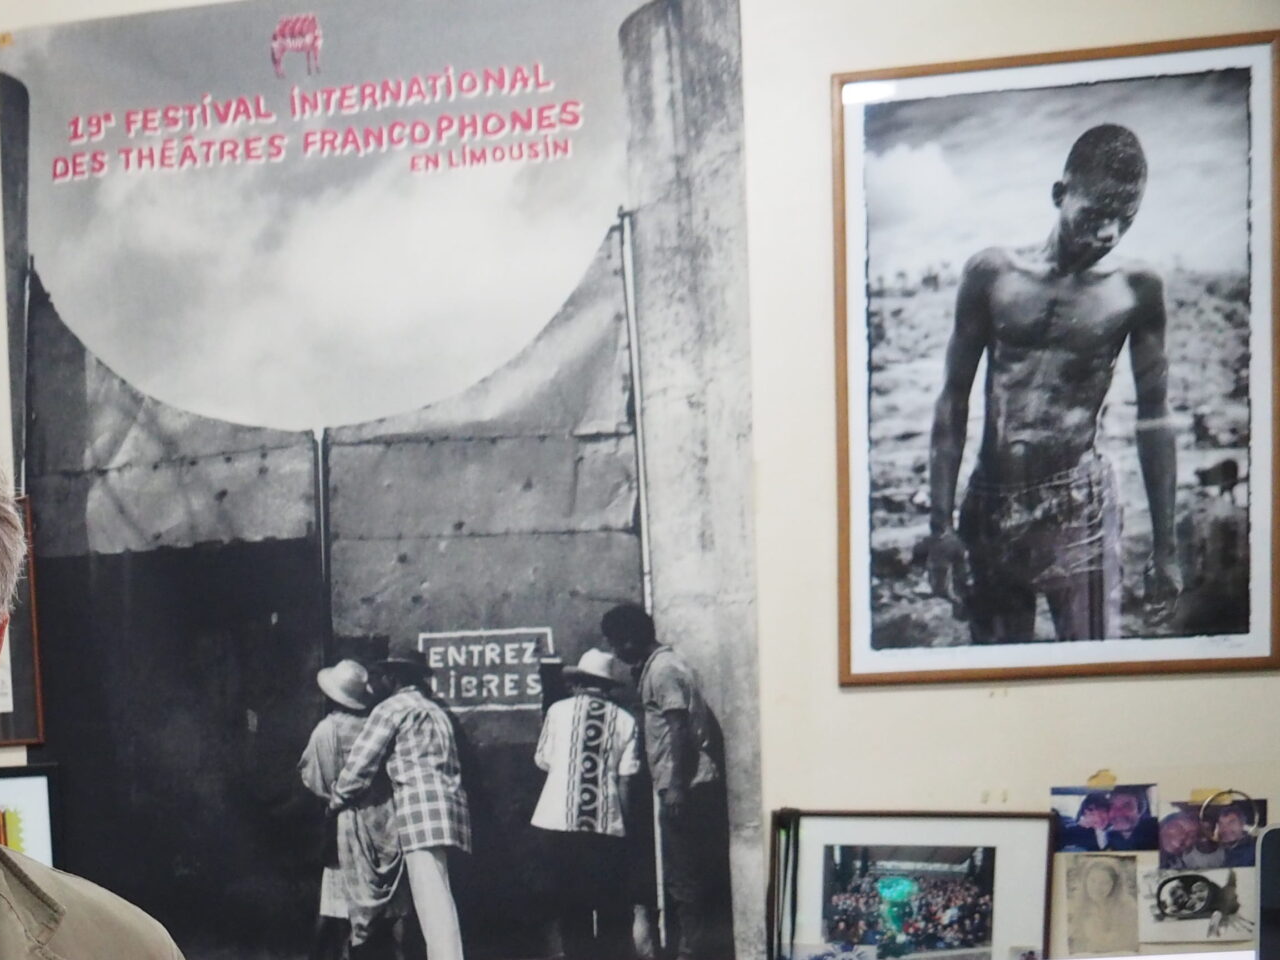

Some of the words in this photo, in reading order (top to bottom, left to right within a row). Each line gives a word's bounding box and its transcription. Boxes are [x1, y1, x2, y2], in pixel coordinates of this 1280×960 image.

[123, 94, 276, 134] FESTIVAL
[289, 62, 554, 118] INTERNATIONAL
[52, 149, 109, 182] DES
[118, 133, 287, 170] THÉÂTRES
[302, 100, 583, 154] FRANCOPHONES
[410, 153, 441, 172] EN
[447, 134, 572, 169] LIMOUSIN
[428, 641, 538, 668] ENTREZ
[431, 669, 543, 699] LIBRES
